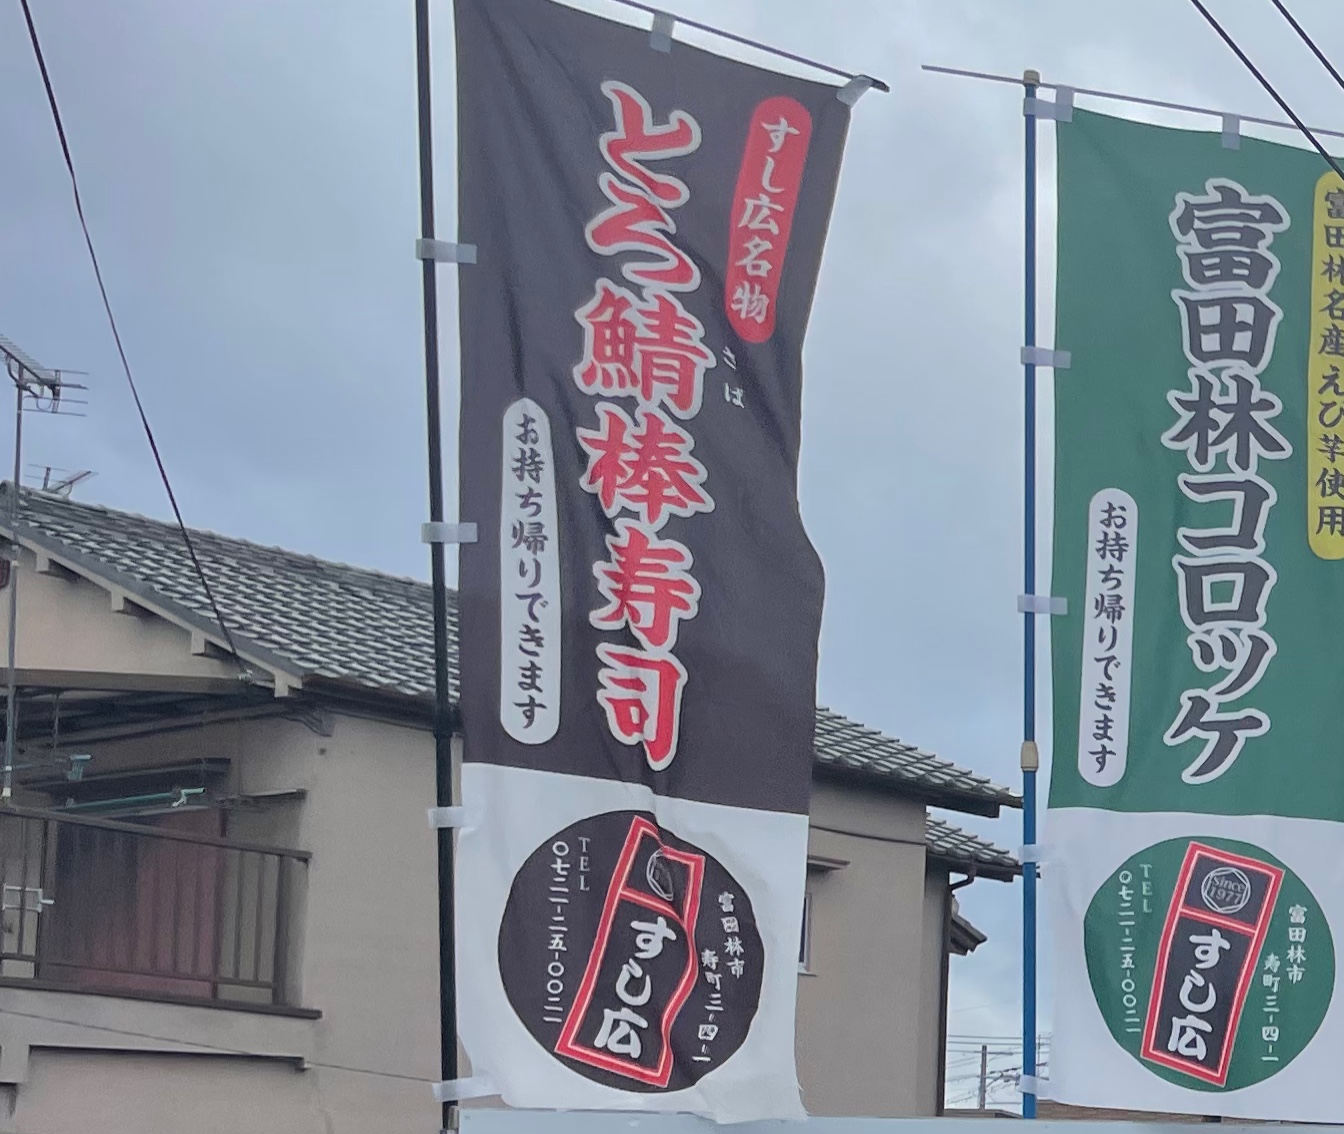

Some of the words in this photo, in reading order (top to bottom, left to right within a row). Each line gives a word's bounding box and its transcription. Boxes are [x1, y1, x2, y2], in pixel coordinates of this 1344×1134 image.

[731, 116, 801, 324] すし広名物
[573, 80, 717, 771] とろ鯖棒寿司
[1160, 177, 1293, 786] 富田林コロッケ
[510, 412, 549, 729] お持ち帰りできます
[1088, 500, 1130, 774] お持ち帰りできます
[577, 836, 592, 892] TEL
[1140, 864, 1152, 913] TEL
[1209, 886, 1242, 905] 1977
[1212, 875, 1245, 893] since
[594, 917, 676, 1059] すし広
[1168, 929, 1231, 1060] すし広
[1286, 904, 1307, 983] 富田林市
